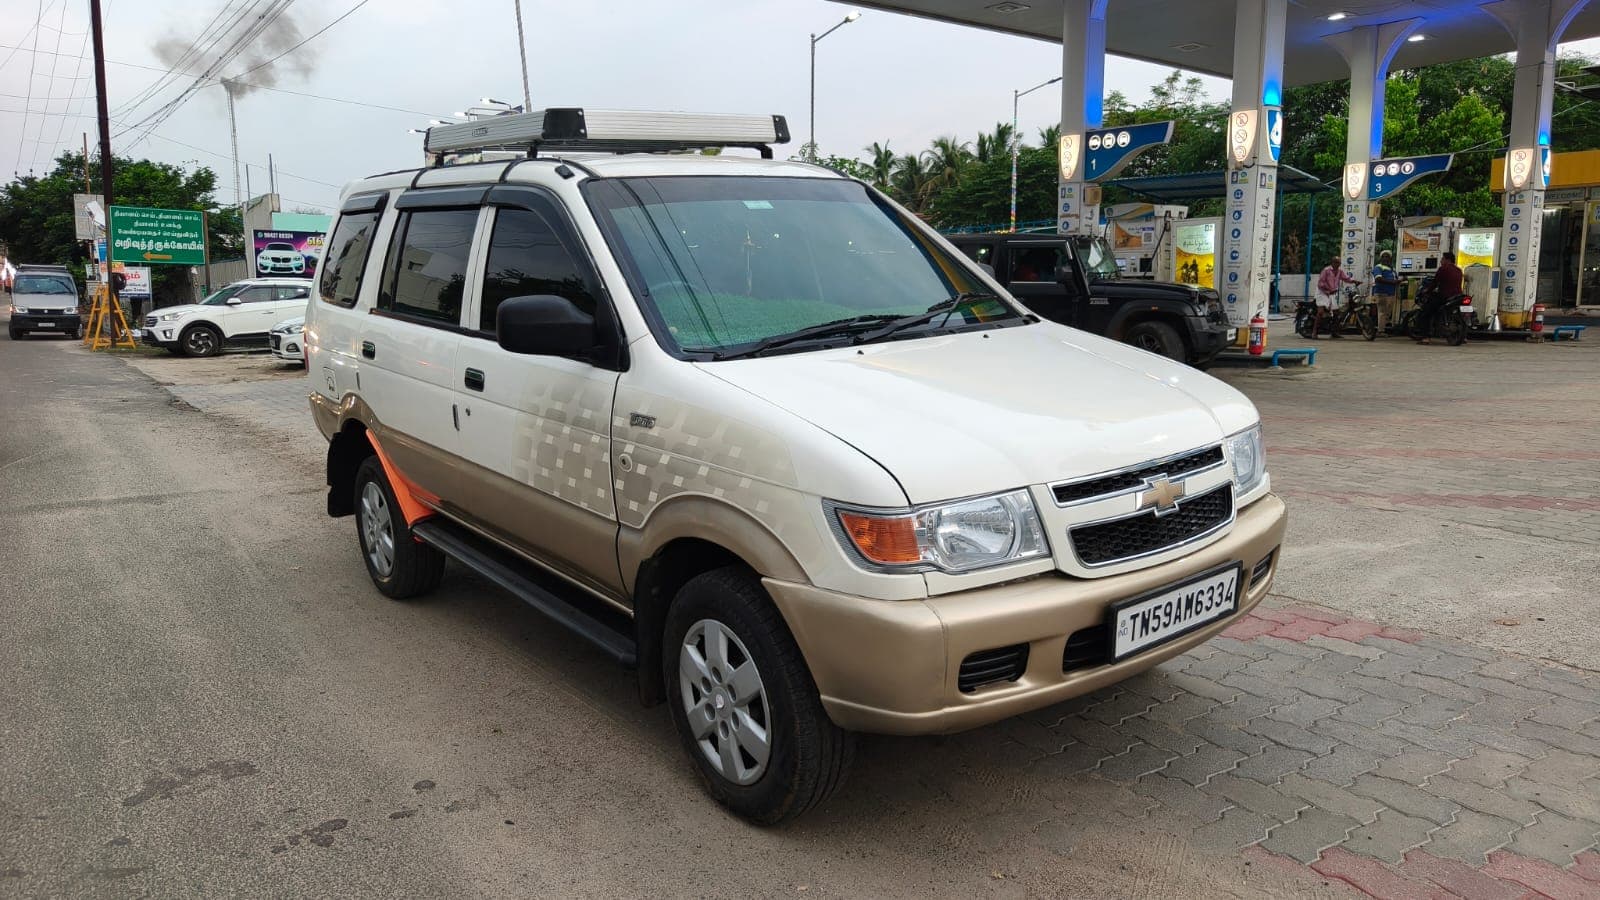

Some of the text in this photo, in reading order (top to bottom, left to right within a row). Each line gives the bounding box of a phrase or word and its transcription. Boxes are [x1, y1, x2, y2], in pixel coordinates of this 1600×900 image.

[1090, 159, 1097, 170] 1
[1375, 182, 1382, 192] 3
[114, 237, 204, 251] அறிவுத்திருக்கோயில்
[1129, 576, 1236, 642] TN59AM6334
